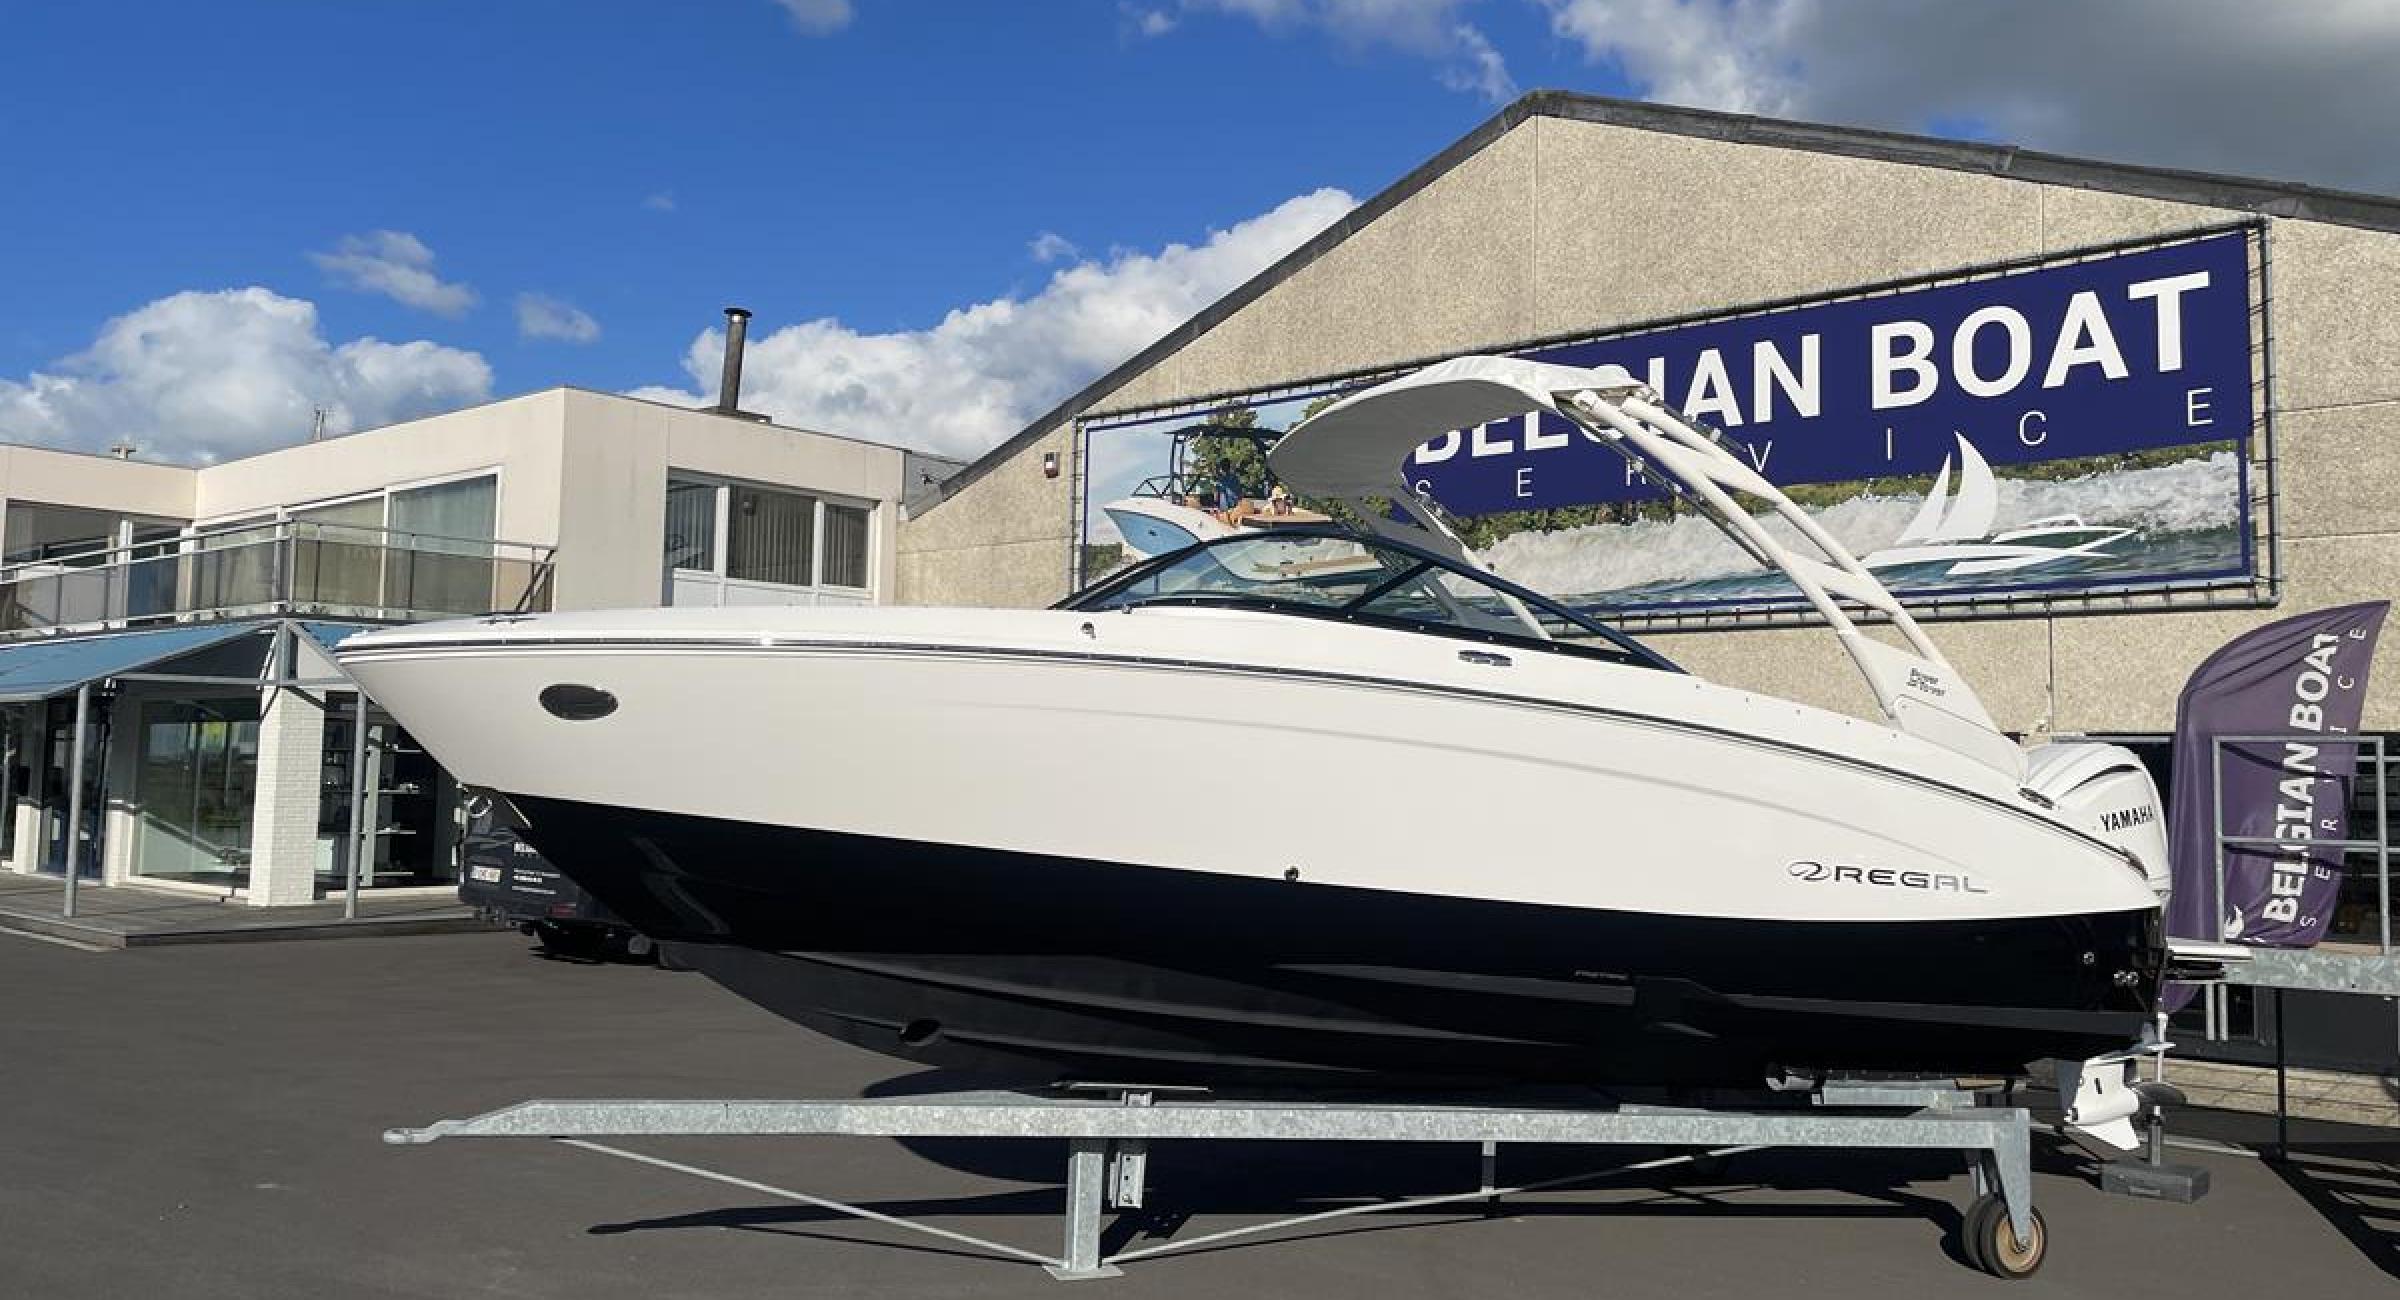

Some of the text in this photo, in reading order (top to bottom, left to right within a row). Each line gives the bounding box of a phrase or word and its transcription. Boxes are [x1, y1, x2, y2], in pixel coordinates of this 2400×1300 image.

[1415, 271, 2210, 464] LIAN BOAT
[2100, 804, 2153, 832] YAMAHA
[2262, 633, 2339, 923] BELGIAN BOAT
[1834, 865, 1989, 894] REGAL
